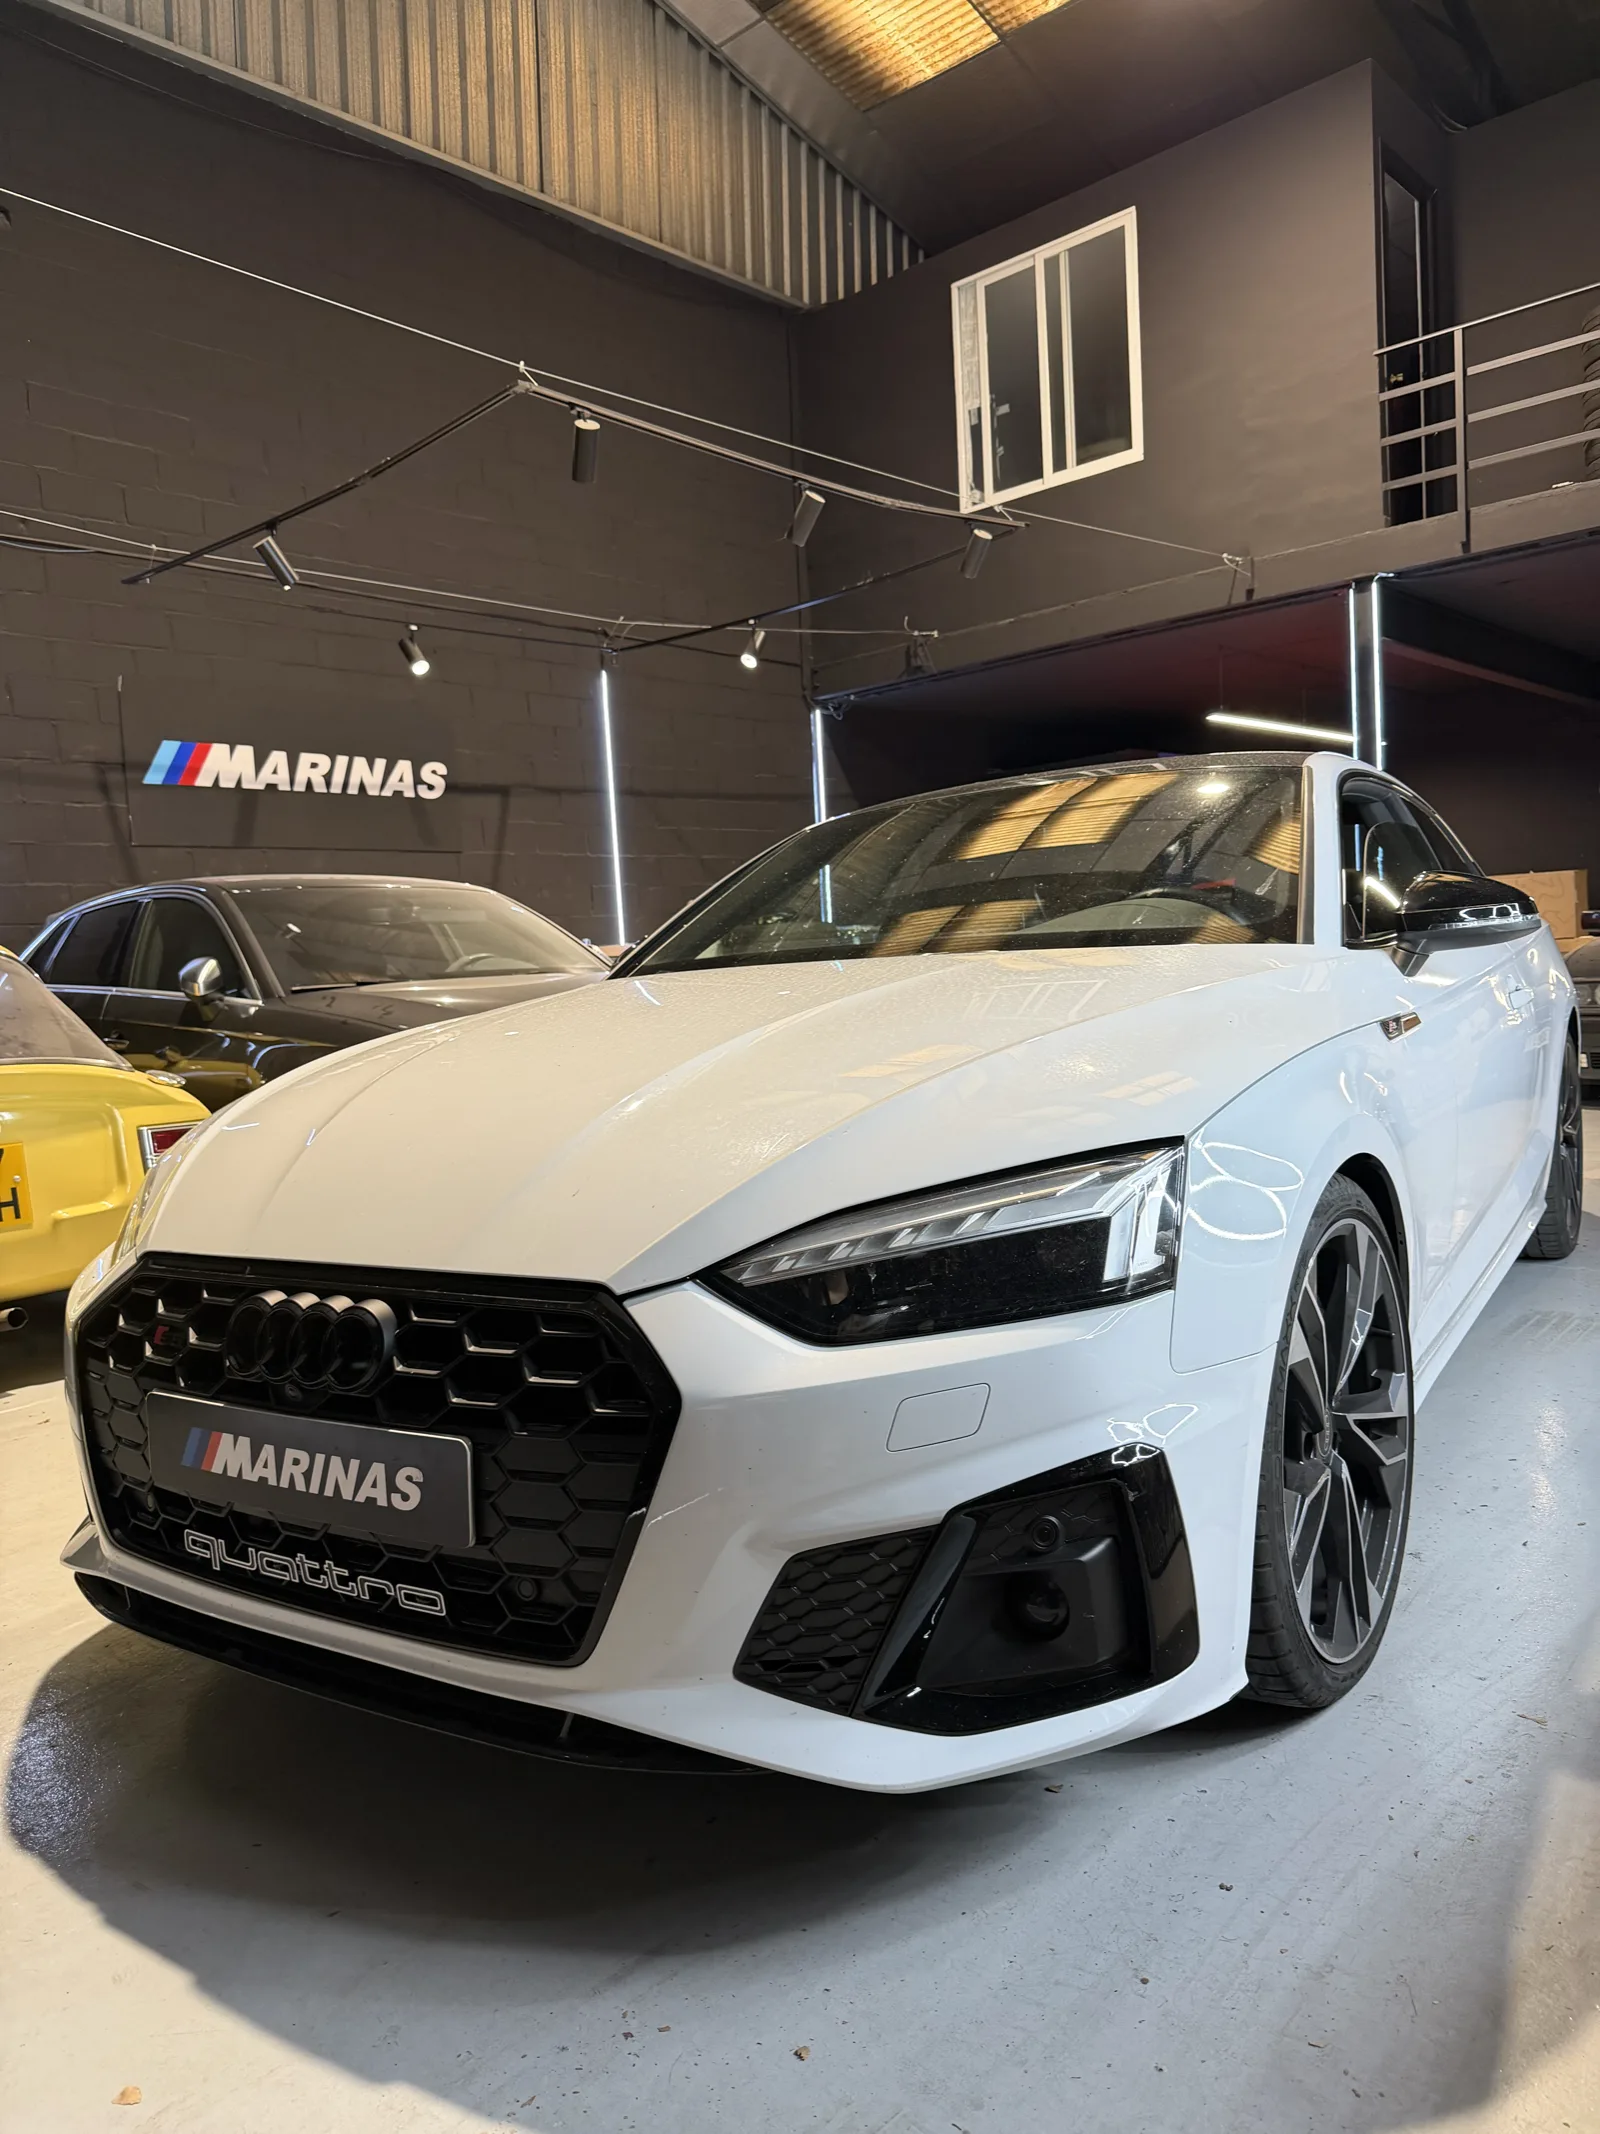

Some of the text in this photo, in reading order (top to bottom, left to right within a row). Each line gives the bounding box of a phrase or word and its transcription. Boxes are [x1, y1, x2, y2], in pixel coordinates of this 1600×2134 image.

[194, 743, 448, 800] MARINAS
[211, 1432, 424, 1511] MARINAS
[184, 1529, 446, 1616] quattro
